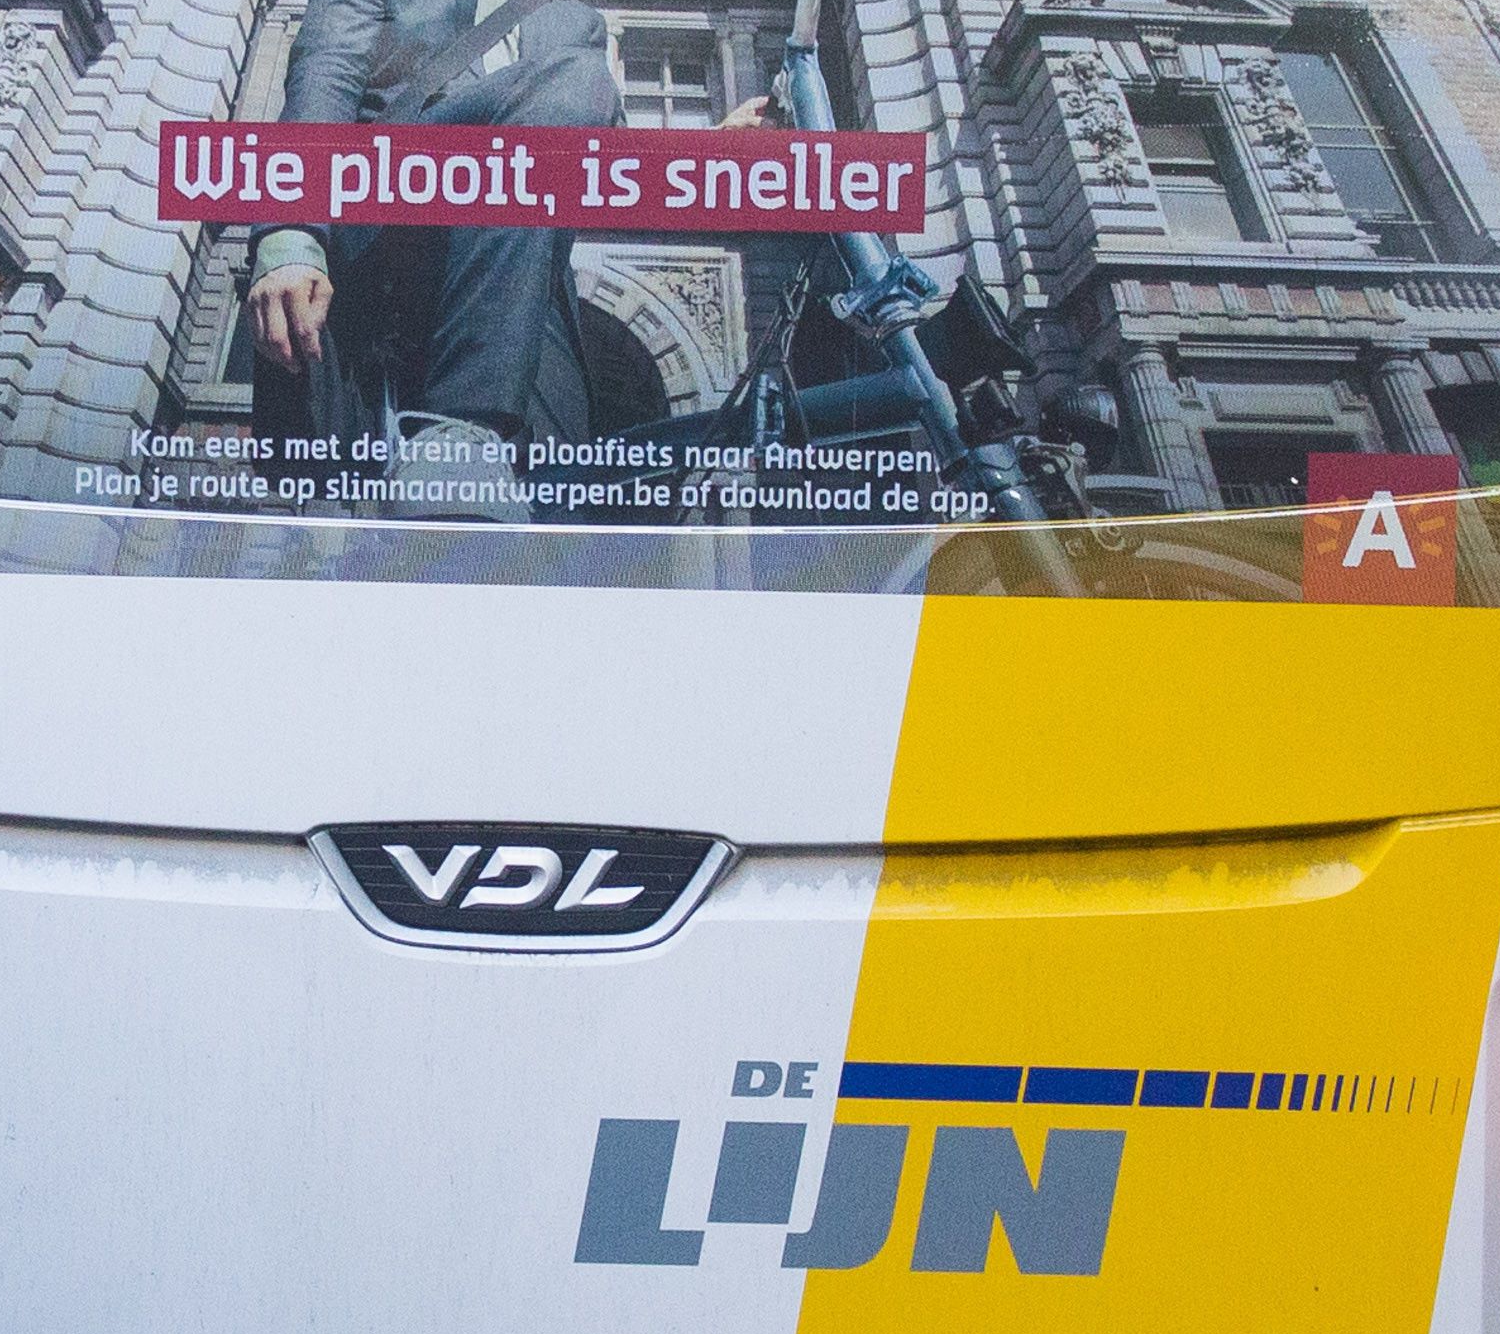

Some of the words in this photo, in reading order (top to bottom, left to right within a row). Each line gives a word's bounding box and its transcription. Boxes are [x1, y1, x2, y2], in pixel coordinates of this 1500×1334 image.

[172, 132, 305, 204] Wie
[330, 135, 558, 217] plooit,
[581, 138, 641, 208] is
[665, 141, 914, 214] sneller
[131, 429, 195, 459] Kom
[205, 436, 275, 460] eens
[284, 434, 341, 461] met
[351, 432, 389, 463] de
[399, 433, 472, 464] trein
[485, 441, 518, 465] en
[528, 436, 673, 475] plooifiets
[685, 446, 754, 469] naar
[764, 442, 941, 479] Antwerpen.
[75, 468, 142, 496] Plan
[149, 469, 179, 503] je
[189, 473, 269, 499] route
[278, 476, 317, 506] op
[325, 470, 672, 512] slimnaarantwerpen.be
[681, 478, 713, 508] of
[719, 480, 871, 511] download
[882, 481, 919, 512] de
[930, 489, 997, 520] app.
[1341, 489, 1417, 570] A
[379, 844, 648, 916] VDL
[729, 1059, 819, 1100] DE
[573, 1117, 1129, 1278] LIJN
